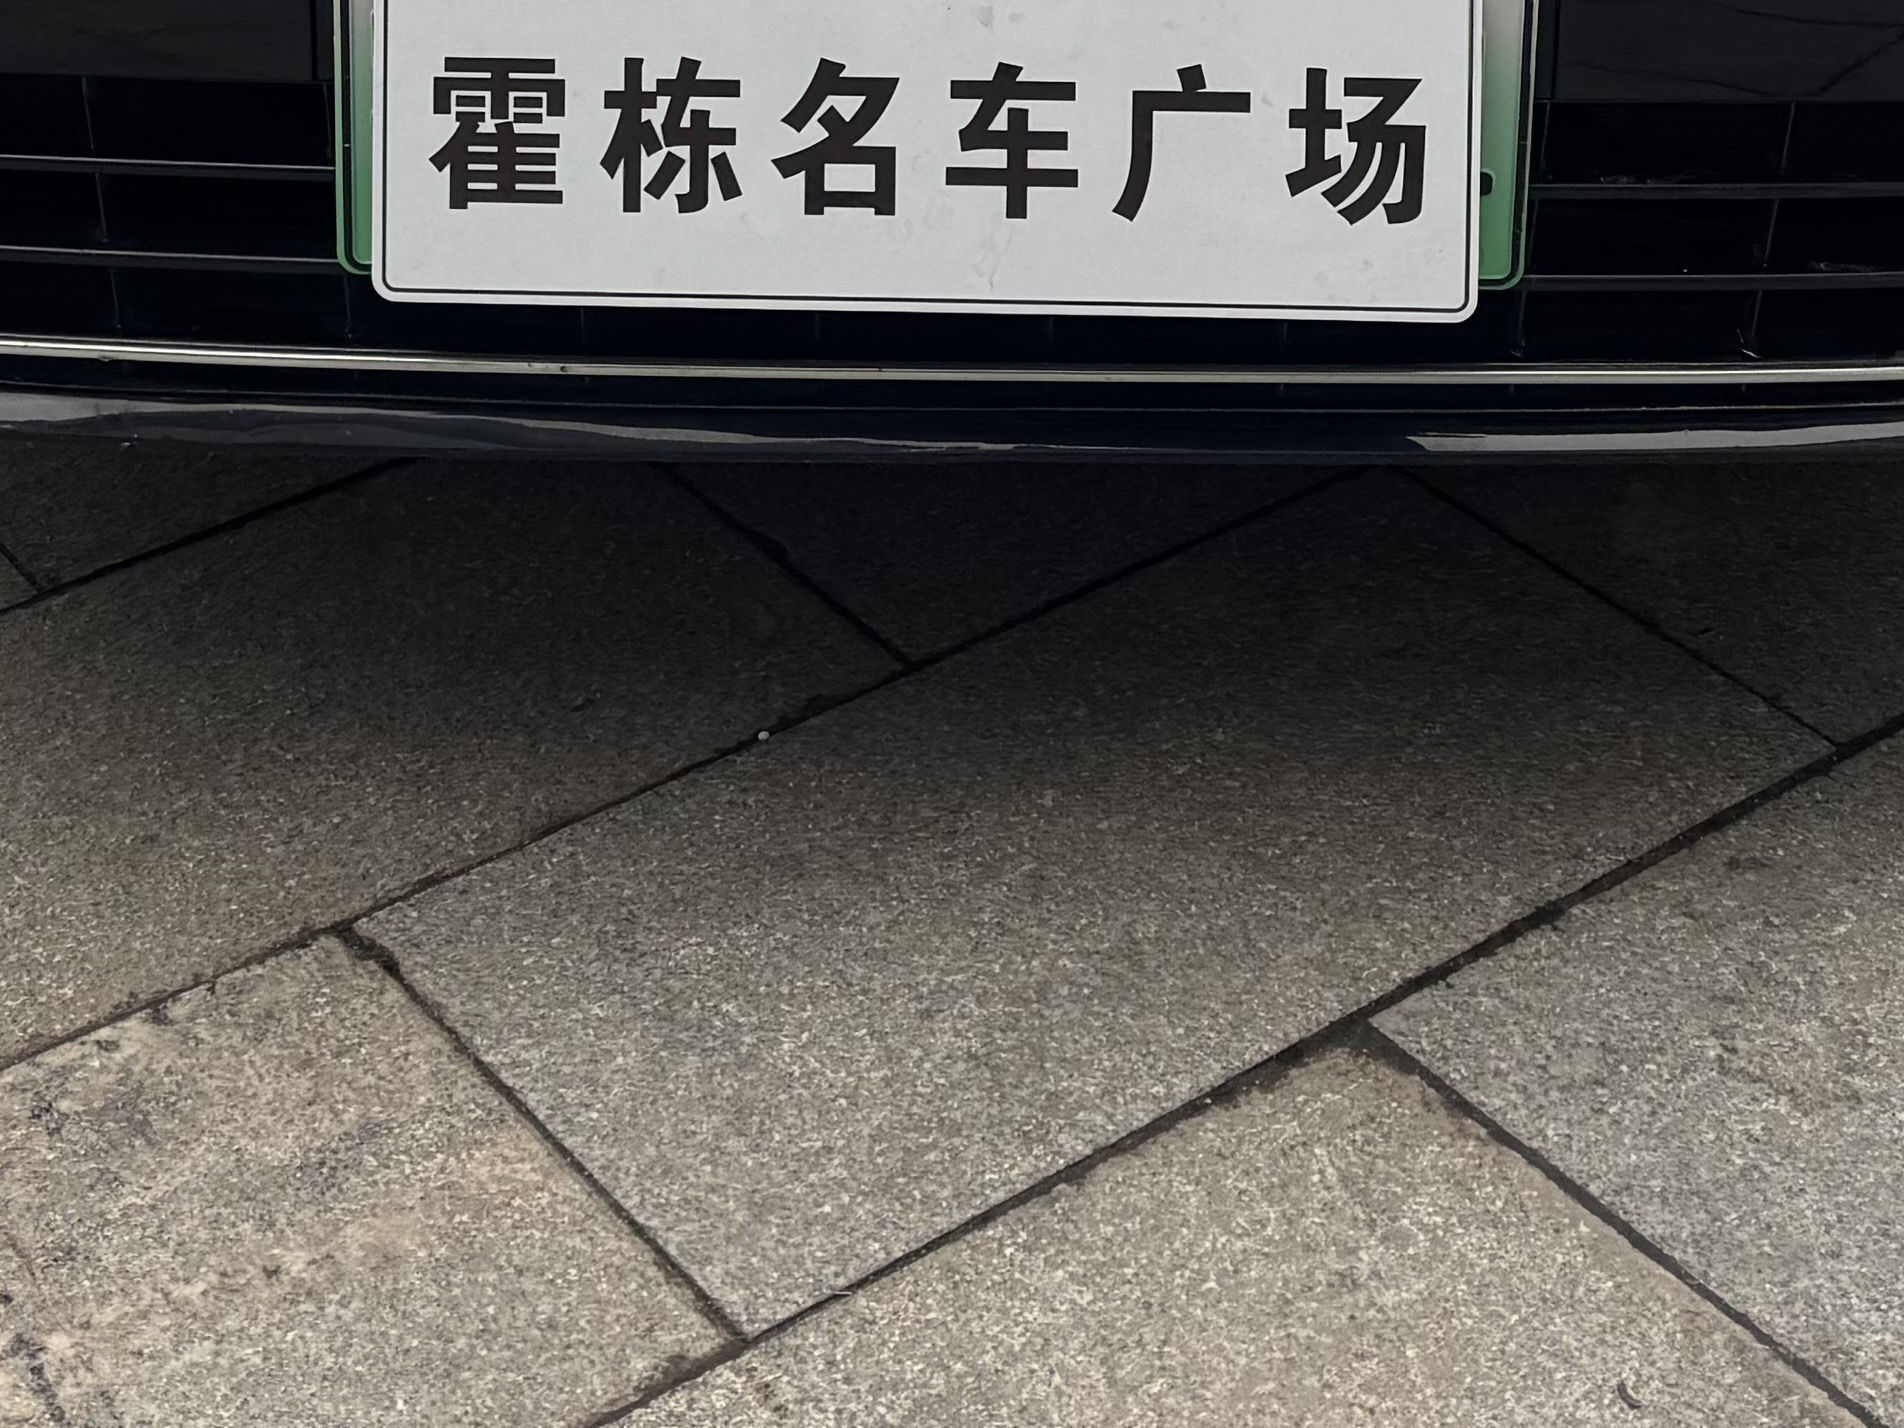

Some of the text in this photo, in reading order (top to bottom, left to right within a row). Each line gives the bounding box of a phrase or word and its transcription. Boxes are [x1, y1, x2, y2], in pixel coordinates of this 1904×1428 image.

[428, 55, 1428, 227] 霍栋名车广场
